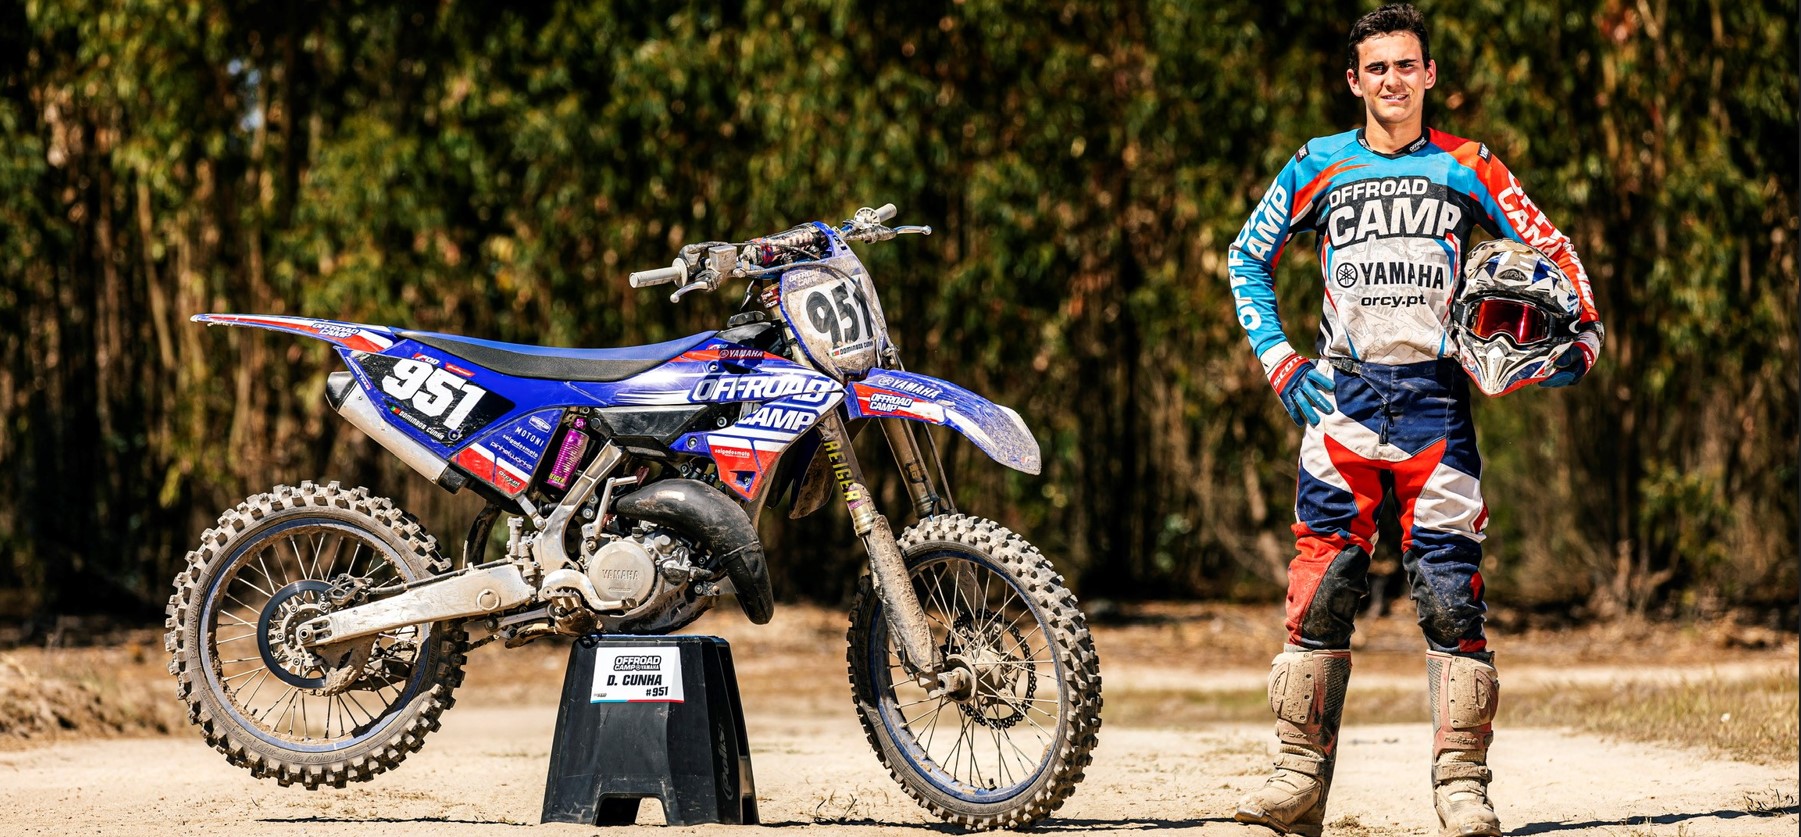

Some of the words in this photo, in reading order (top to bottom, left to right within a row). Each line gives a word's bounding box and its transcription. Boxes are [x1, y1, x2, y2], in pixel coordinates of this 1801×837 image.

[1329, 178, 1429, 208] OFFROAD
[1328, 197, 1462, 247] CAMP
[1359, 261, 1444, 290] YAMAHA
[1360, 294, 1427, 308] orcy.pt
[805, 277, 874, 350] 951
[728, 349, 764, 358] YAMAHA
[381, 358, 487, 430] 951
[691, 375, 828, 404] OFFROAD
[891, 379, 941, 399] YAMAHA
[869, 401, 898, 412] CAMP
[870, 393, 914, 407] OFFROAD
[514, 426, 545, 447] MOTONI
[601, 568, 640, 581] YAMAHA
[615, 656, 661, 665] OFFROAD
[606, 674, 618, 686] D.
[622, 674, 662, 686] CUNHA
[645, 686, 669, 697] #951
